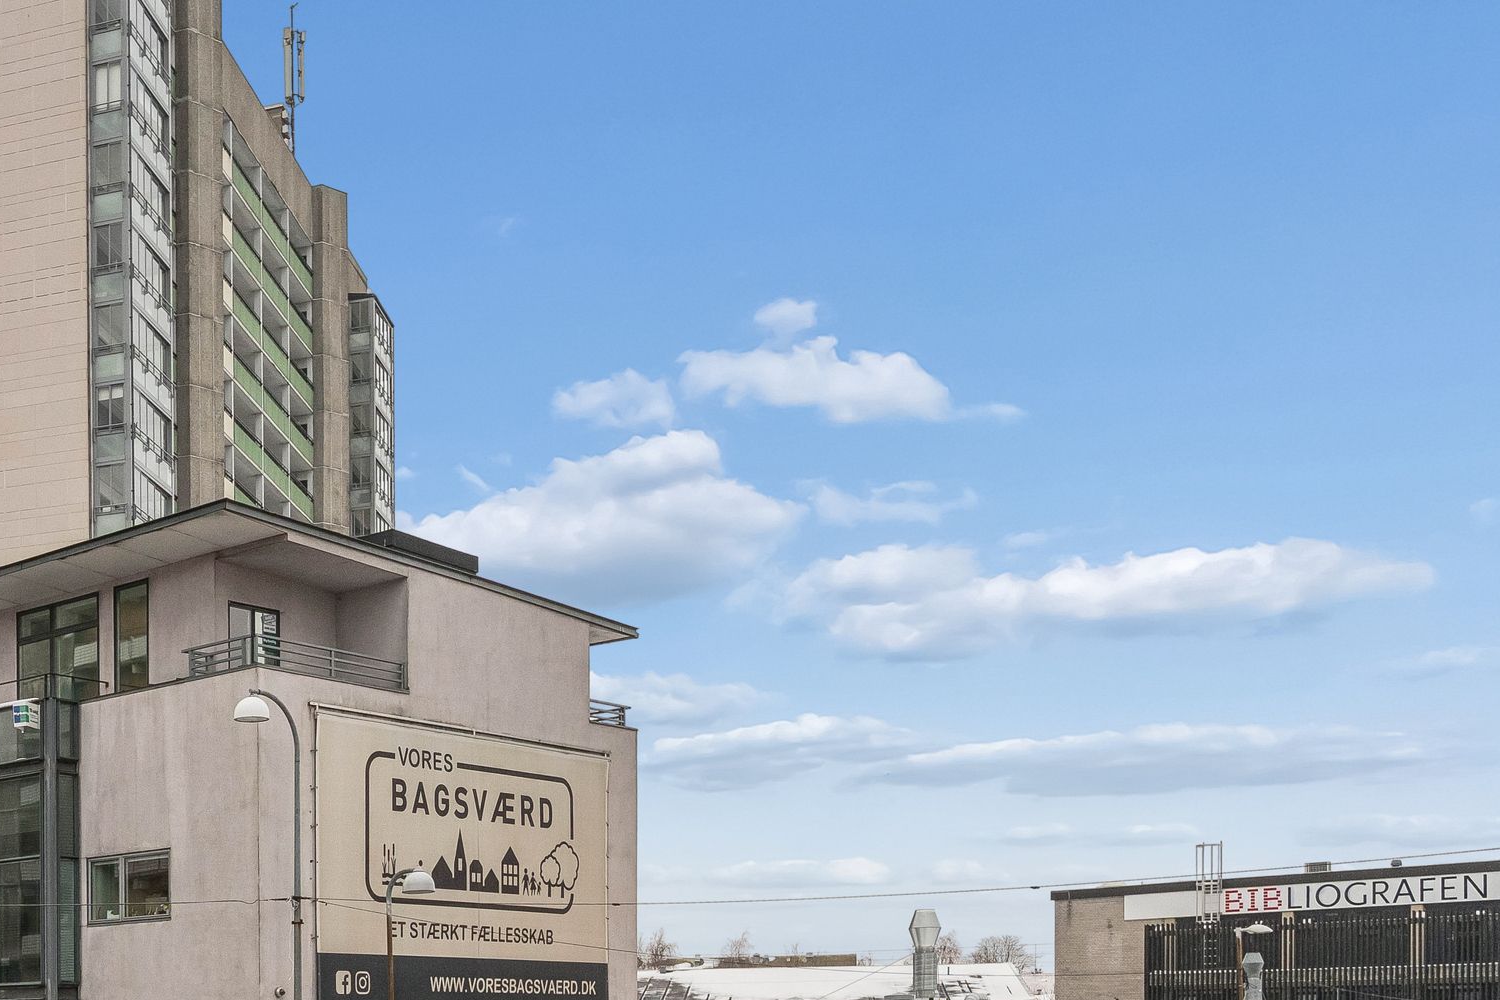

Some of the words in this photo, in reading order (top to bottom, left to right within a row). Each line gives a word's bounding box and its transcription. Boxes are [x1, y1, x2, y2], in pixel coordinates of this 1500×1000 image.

[398, 746, 453, 772] VORES
[392, 778, 553, 829] BAGSVÆRD
[1224, 873, 1488, 913] BIBLIOGRAFEN
[391, 921, 406, 938] ET
[409, 922, 468, 942] STÆRKT
[471, 925, 554, 945] FÆLLESSKAB
[430, 976, 597, 996] WWW.VORESBAGSVAERD.DK
